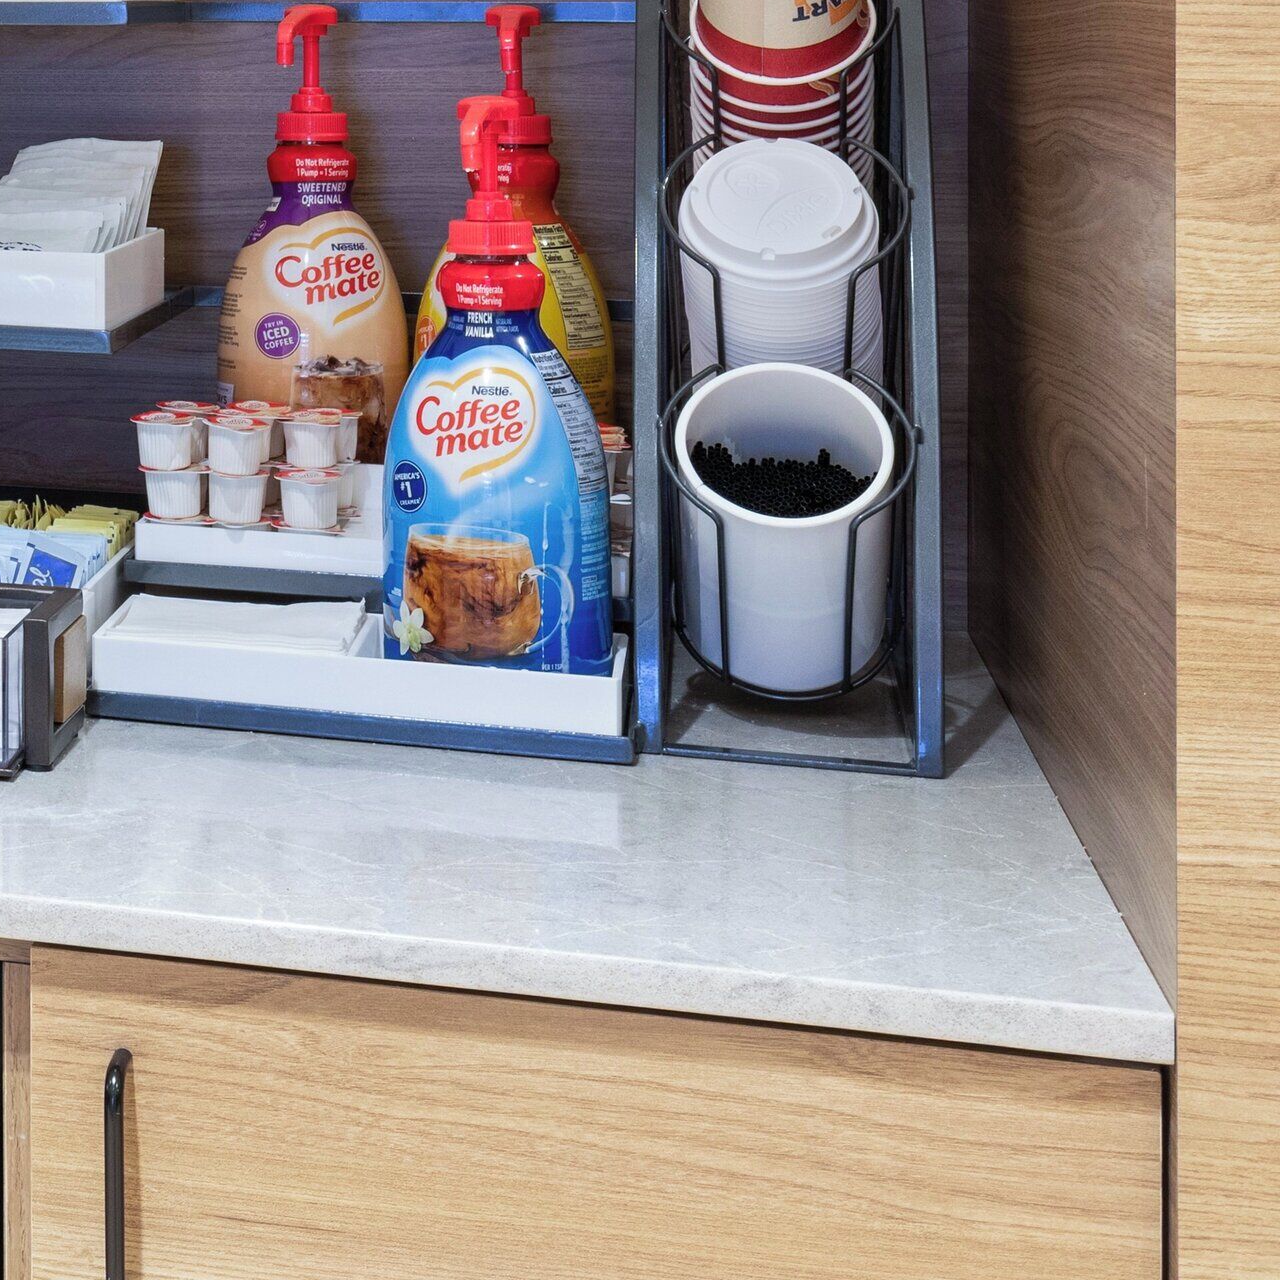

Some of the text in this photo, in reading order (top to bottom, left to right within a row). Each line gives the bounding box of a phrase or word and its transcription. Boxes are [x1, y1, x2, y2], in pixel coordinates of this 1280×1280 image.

[295, 159, 304, 167] Do
[305, 159, 318, 167] Not
[300, 169, 318, 178] Pump
[328, 168, 349, 178] Serving
[297, 182, 347, 193] SWEETENED
[301, 195, 342, 205] ORIGINAL
[331, 242, 366, 252] Nestlé
[274, 252, 376, 289] Coffee
[304, 269, 381, 306] mate
[455, 282, 504, 296] Do Not Refrigerate
[481, 296, 503, 307] Serving
[467, 311, 493, 324] FRENCH
[262, 326, 290, 341] ICED
[465, 325, 495, 338] VANILLA
[264, 336, 295, 350] COFFEE
[471, 385, 510, 397] Nestlé
[416, 395, 521, 436] Coffee
[436, 420, 524, 457] mate
[394, 472, 420, 481] AMERICA'S
[400, 481, 413, 498] #1
